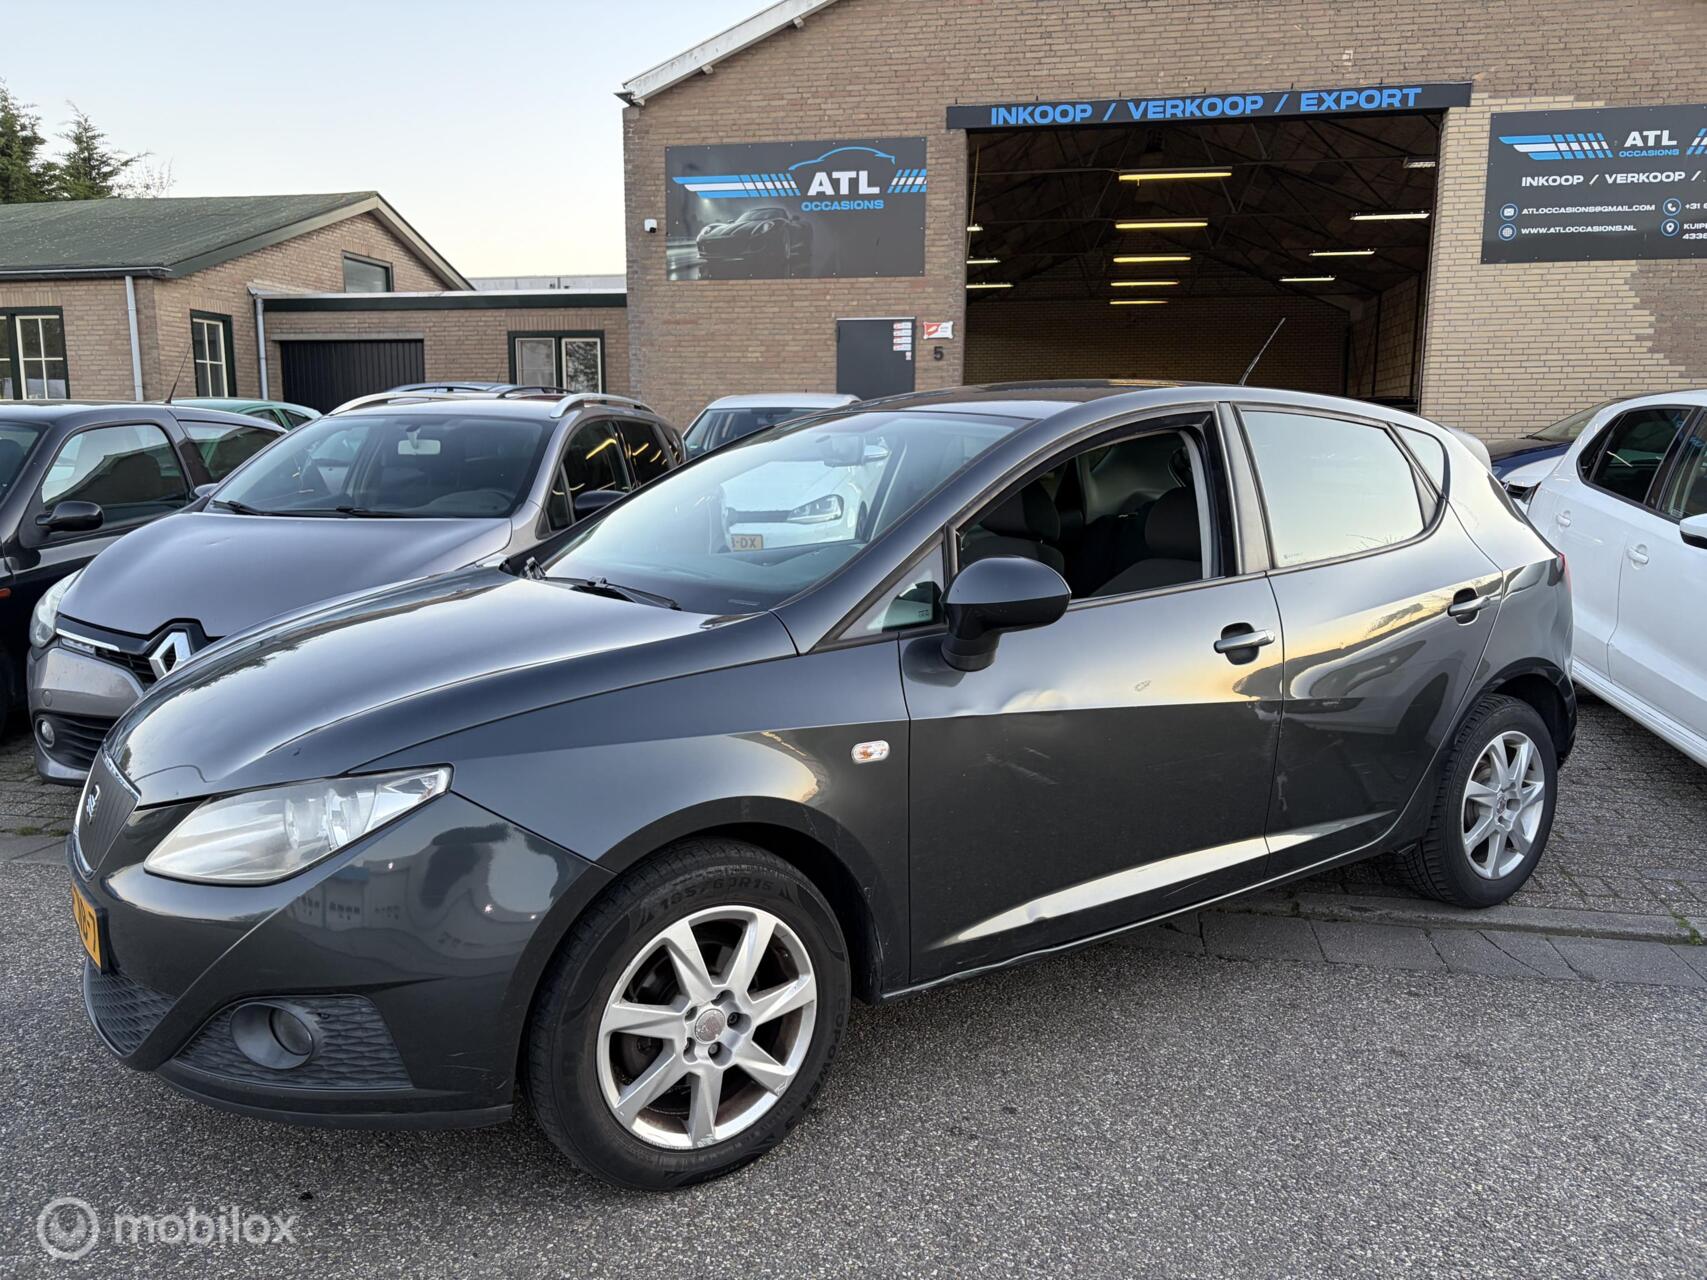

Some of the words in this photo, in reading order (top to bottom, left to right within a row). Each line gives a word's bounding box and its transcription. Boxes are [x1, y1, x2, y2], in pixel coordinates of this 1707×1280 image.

[991, 105, 1093, 126] INKOOP
[1103, 103, 1118, 121] /
[1127, 95, 1264, 120] VERKOOP
[1274, 94, 1290, 113] /
[1300, 88, 1422, 112] EXPORT
[1624, 130, 1677, 148] ATL
[1619, 149, 1680, 158] OCCASIONS
[807, 171, 880, 196] ATL
[1521, 175, 1584, 187] INKOOP
[1589, 174, 1600, 185] /
[1605, 171, 1686, 184] VERKOOP
[801, 200, 884, 212] OCCASIONS
[1521, 204, 1656, 215] ATLOCCASIONS@GMAIL.COM
[1521, 225, 1637, 235] WWW.ATLOCCASIONS.NL
[934, 346, 944, 360] 5
